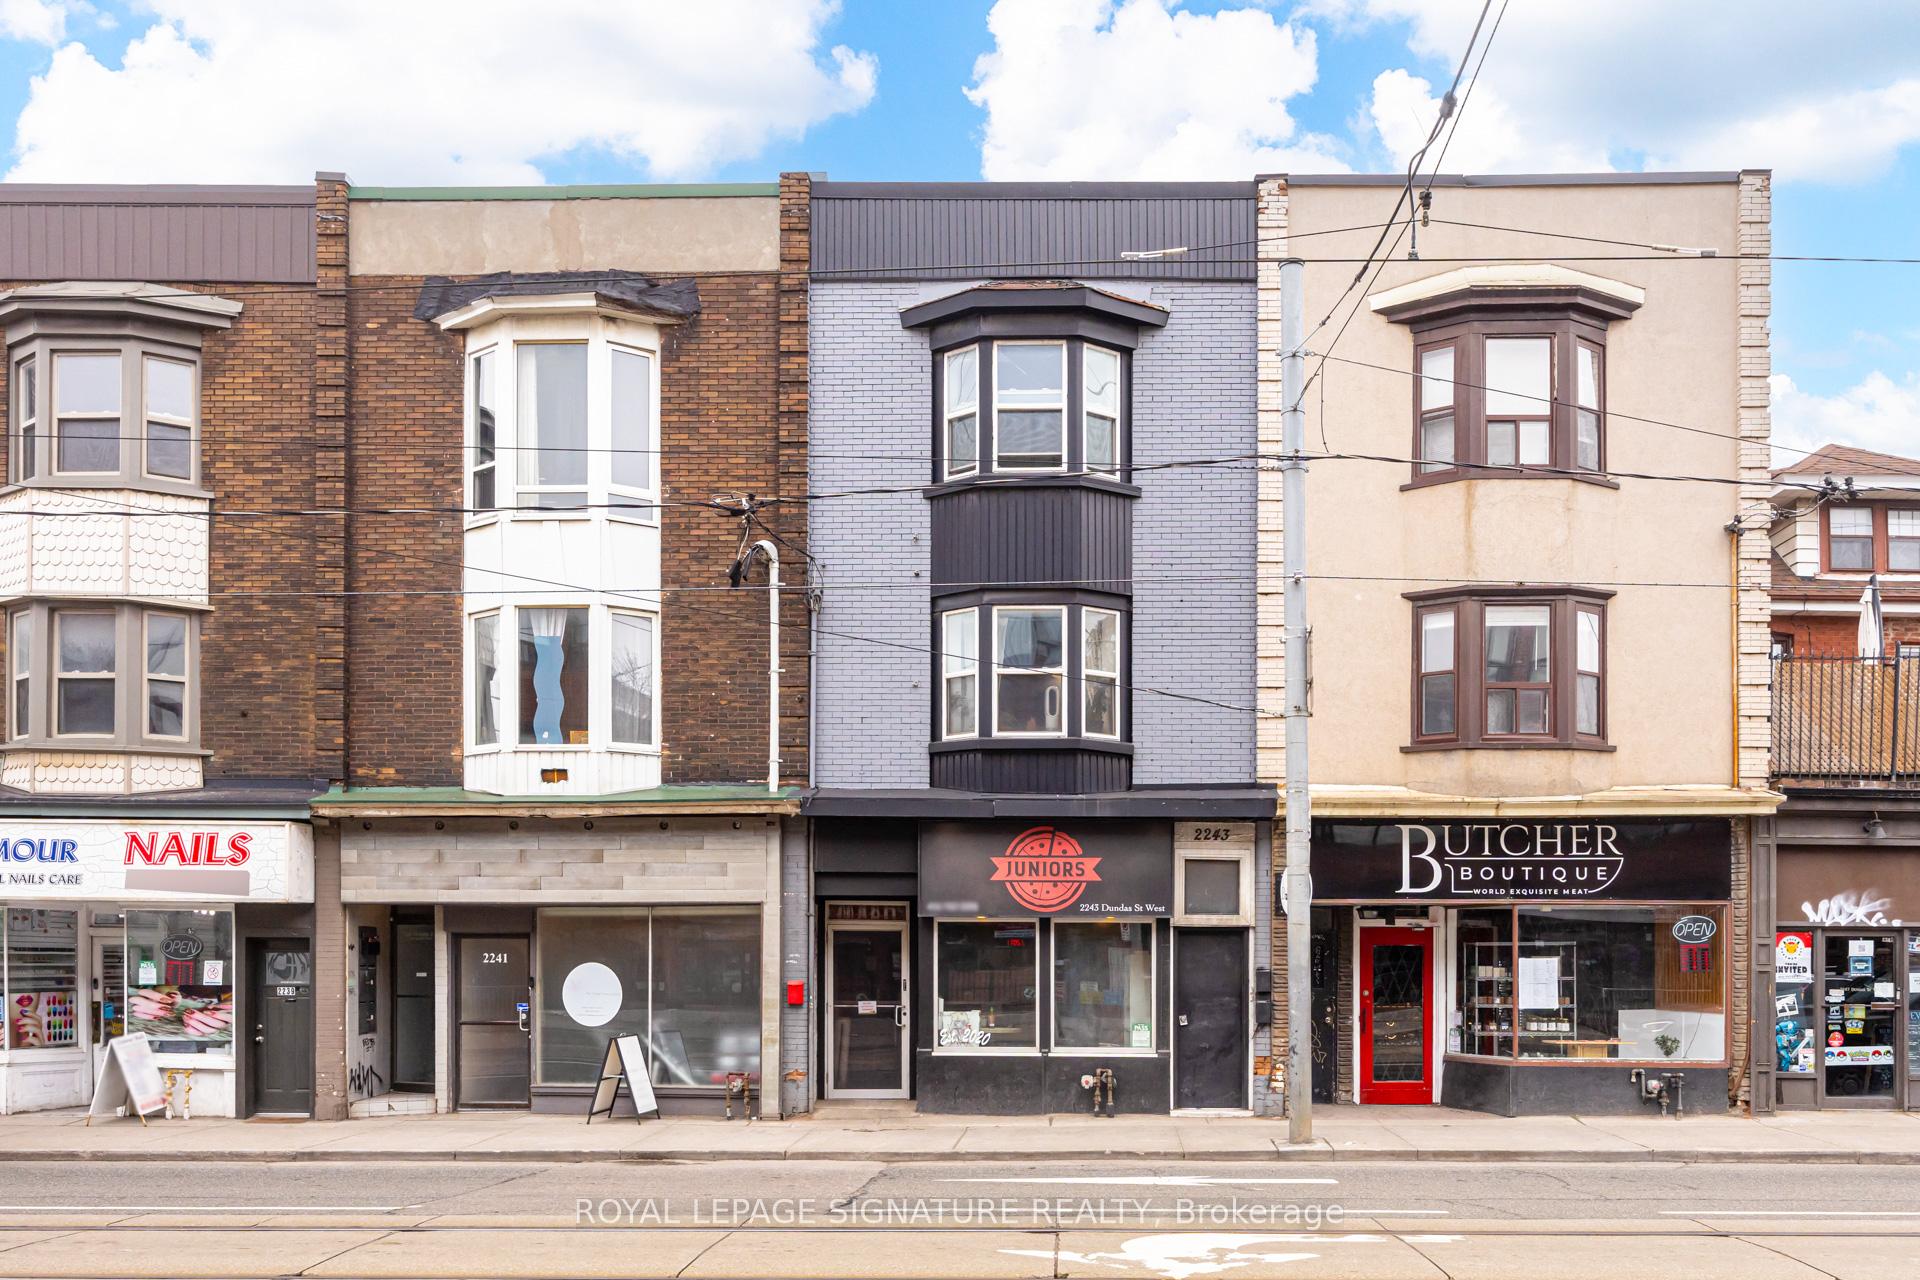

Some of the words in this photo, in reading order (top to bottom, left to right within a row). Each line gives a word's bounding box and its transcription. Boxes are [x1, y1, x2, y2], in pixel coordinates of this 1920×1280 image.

[1194, 828, 1231, 841] 2243
[124, 832, 253, 866] NAILS
[1395, 824, 1623, 894] BUTCHER
[1006, 860, 1084, 877] JUNIORS
[1461, 866, 1608, 882] BOUTIQUE
[9, 873, 45, 884] NAILS
[49, 873, 82, 885] CARE
[1080, 904, 1099, 912] 2243
[1101, 903, 1132, 912] Dundas
[1134, 903, 1143, 912] St
[1144, 903, 1166, 912] West
[1675, 922, 1712, 936] OPEN
[163, 940, 197, 954] OPEN
[482, 953, 508, 964] 2241
[277, 987, 295, 996] 2239
[963, 1029, 991, 1046] 2020
